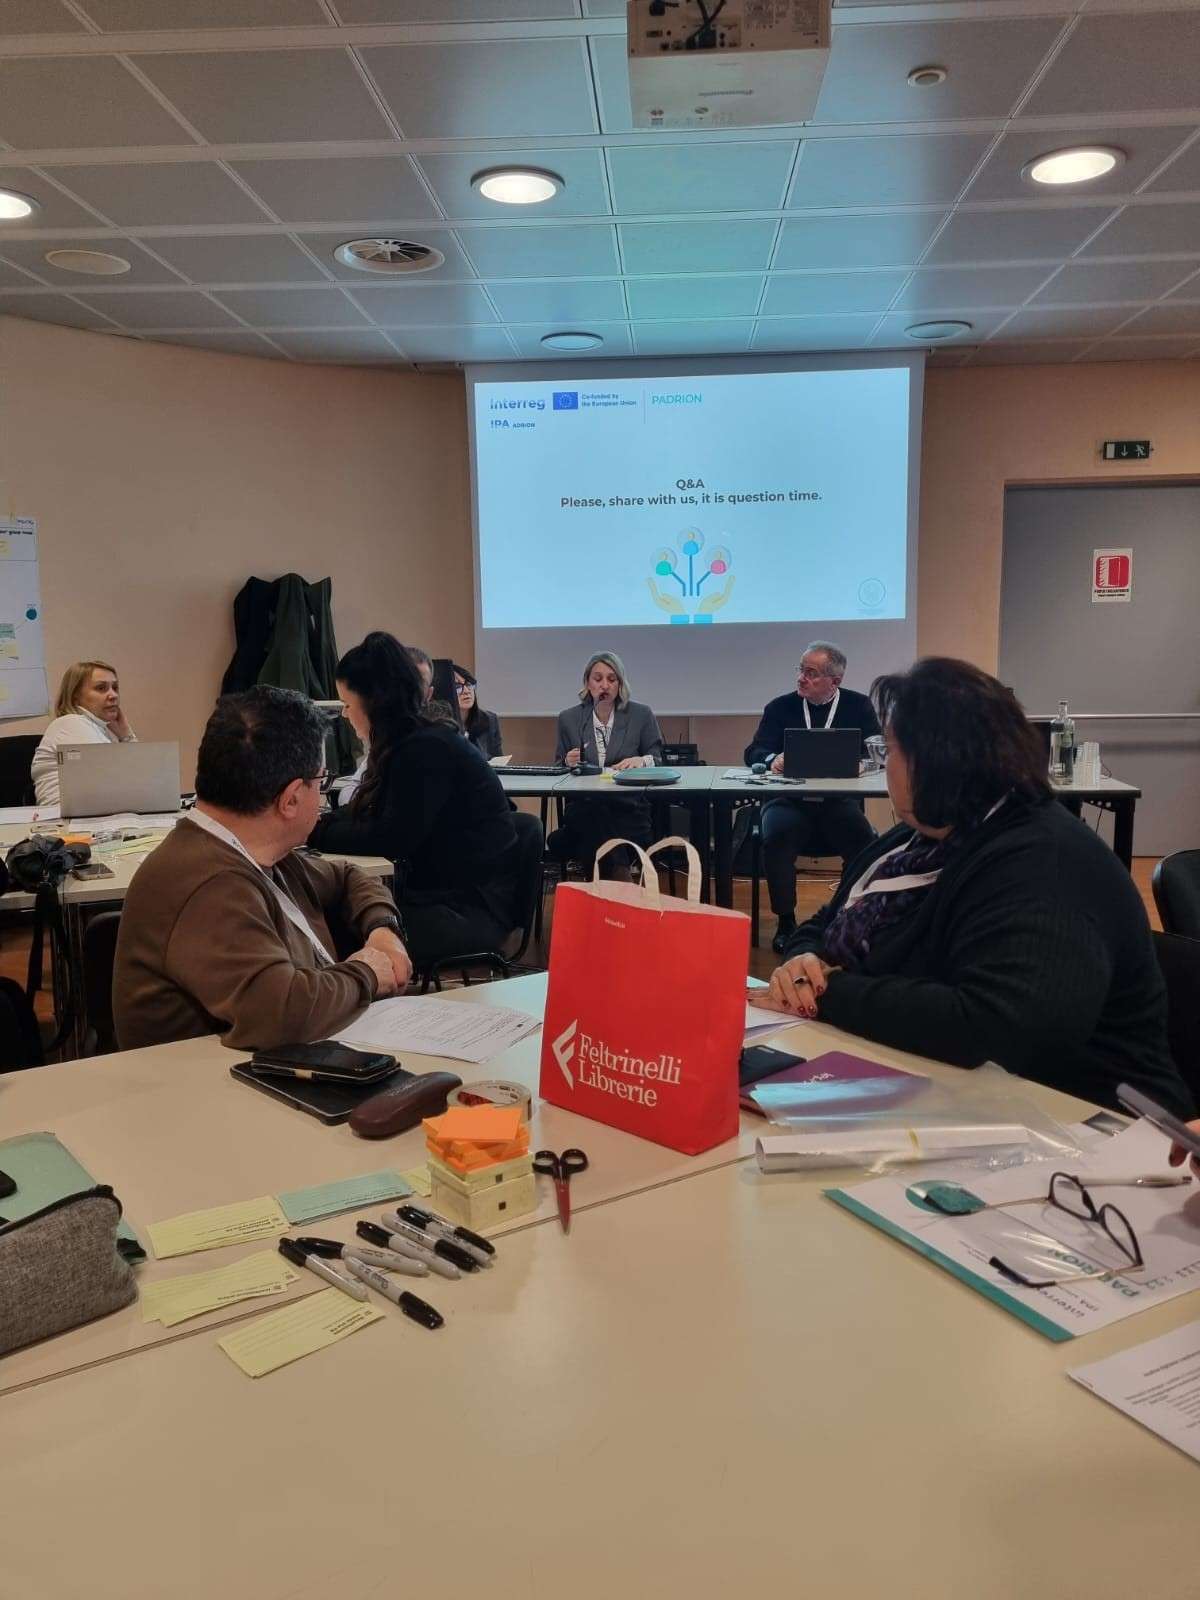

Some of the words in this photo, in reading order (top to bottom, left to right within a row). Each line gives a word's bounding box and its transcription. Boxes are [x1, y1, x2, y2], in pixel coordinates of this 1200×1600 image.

[651, 394, 702, 405] PADRION
[676, 478, 705, 490] Q&A
[560, 497, 606, 508] Please,
[609, 495, 645, 506] share
[647, 493, 677, 506] with
[680, 494, 699, 506] us,
[701, 492, 711, 504] it
[714, 491, 725, 503] is
[727, 491, 785, 505] question
[788, 490, 822, 502] time.
[578, 1032, 682, 1085] Feltrinelli
[578, 1058, 658, 1108] Librerie
